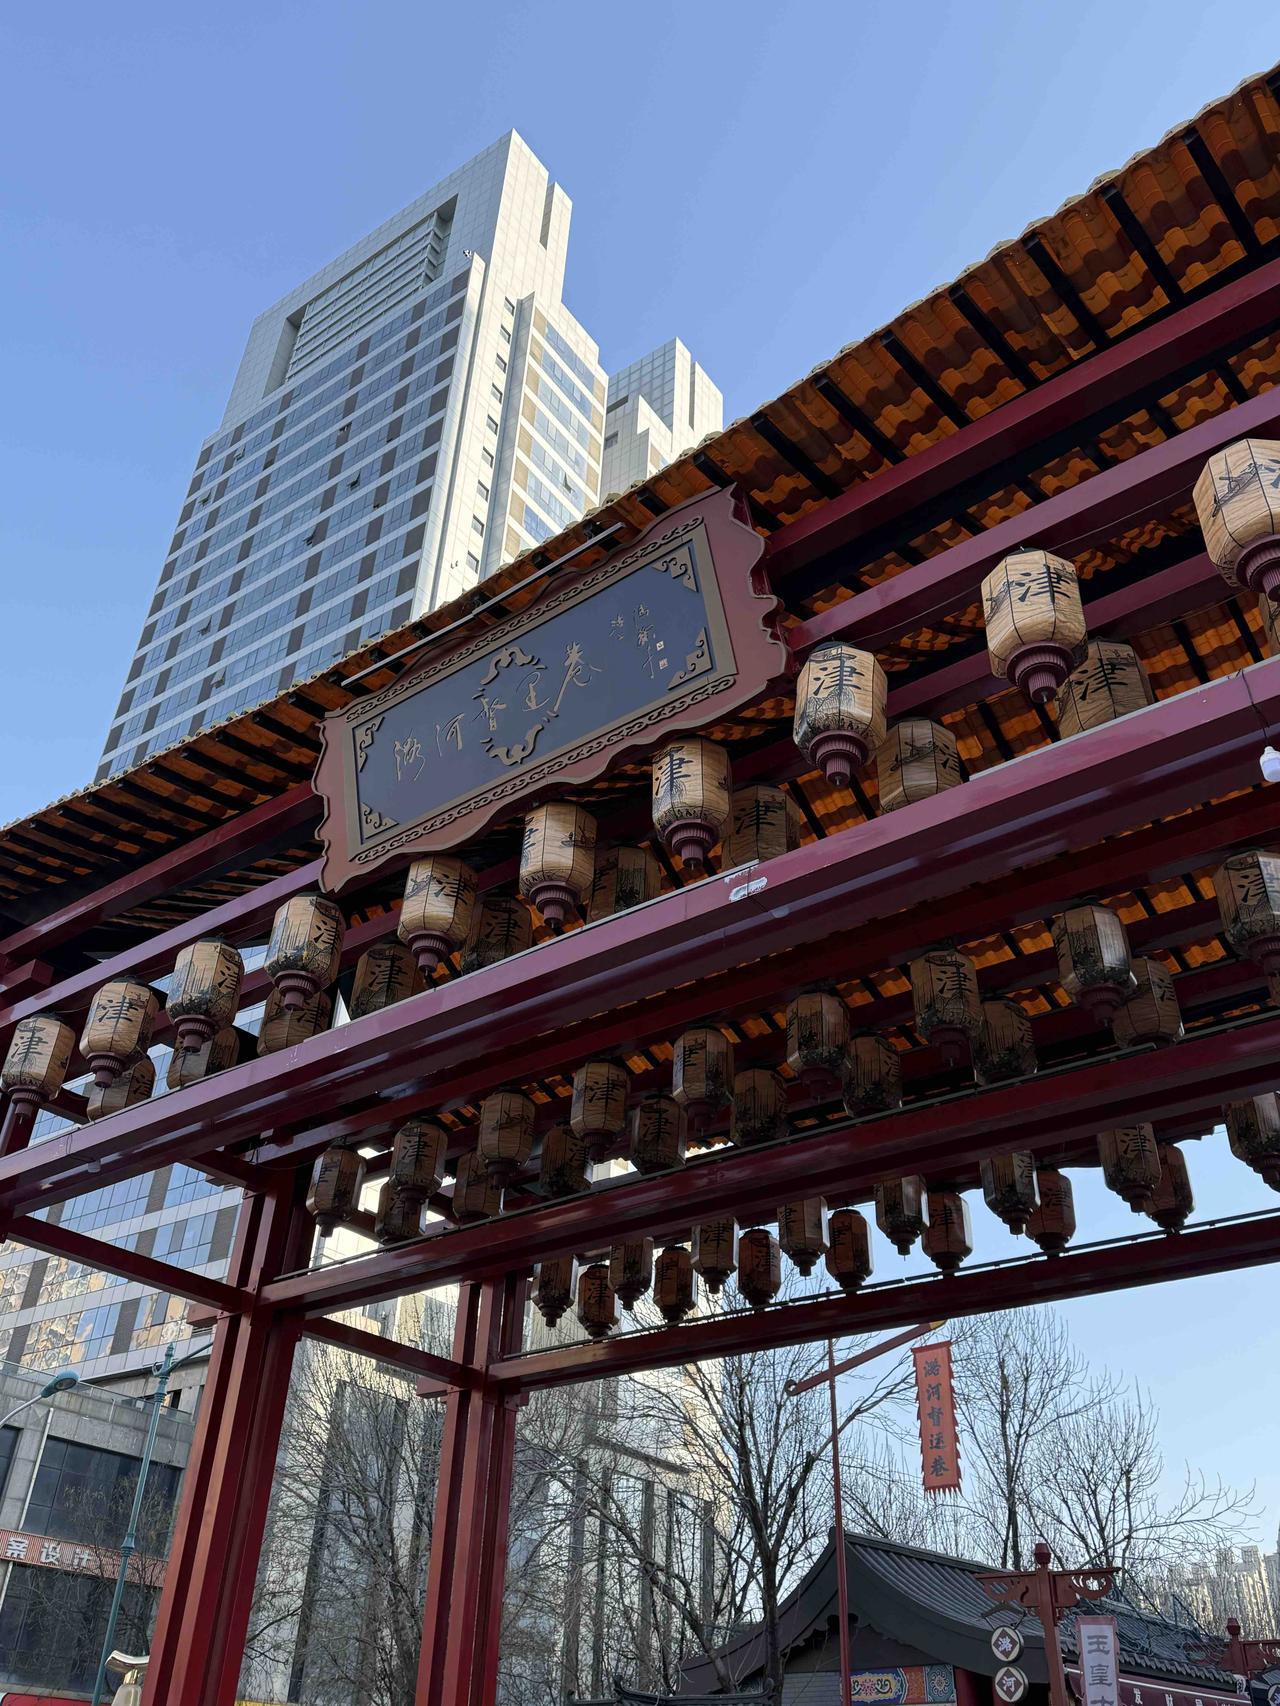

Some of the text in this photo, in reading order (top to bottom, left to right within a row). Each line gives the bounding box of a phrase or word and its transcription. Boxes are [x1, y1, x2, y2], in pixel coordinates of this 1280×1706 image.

[1015, 563, 1072, 604] 津
[813, 656, 866, 697] 津
[1075, 657, 1128, 700] 津
[655, 751, 693, 796] 津
[734, 799, 784, 836] 津
[434, 871, 475, 905] 津
[485, 910, 522, 942] 津
[368, 956, 408, 991] 津
[936, 966, 972, 996] 津
[98, 996, 139, 1023] 津
[11, 1030, 49, 1062] 津
[586, 1077, 622, 1103] 津
[642, 1109, 674, 1142] 津
[401, 1131, 432, 1160] 津
[1120, 1130, 1152, 1154] 津
[930, 1205, 955, 1229] 津
[701, 1223, 733, 1249] 津
